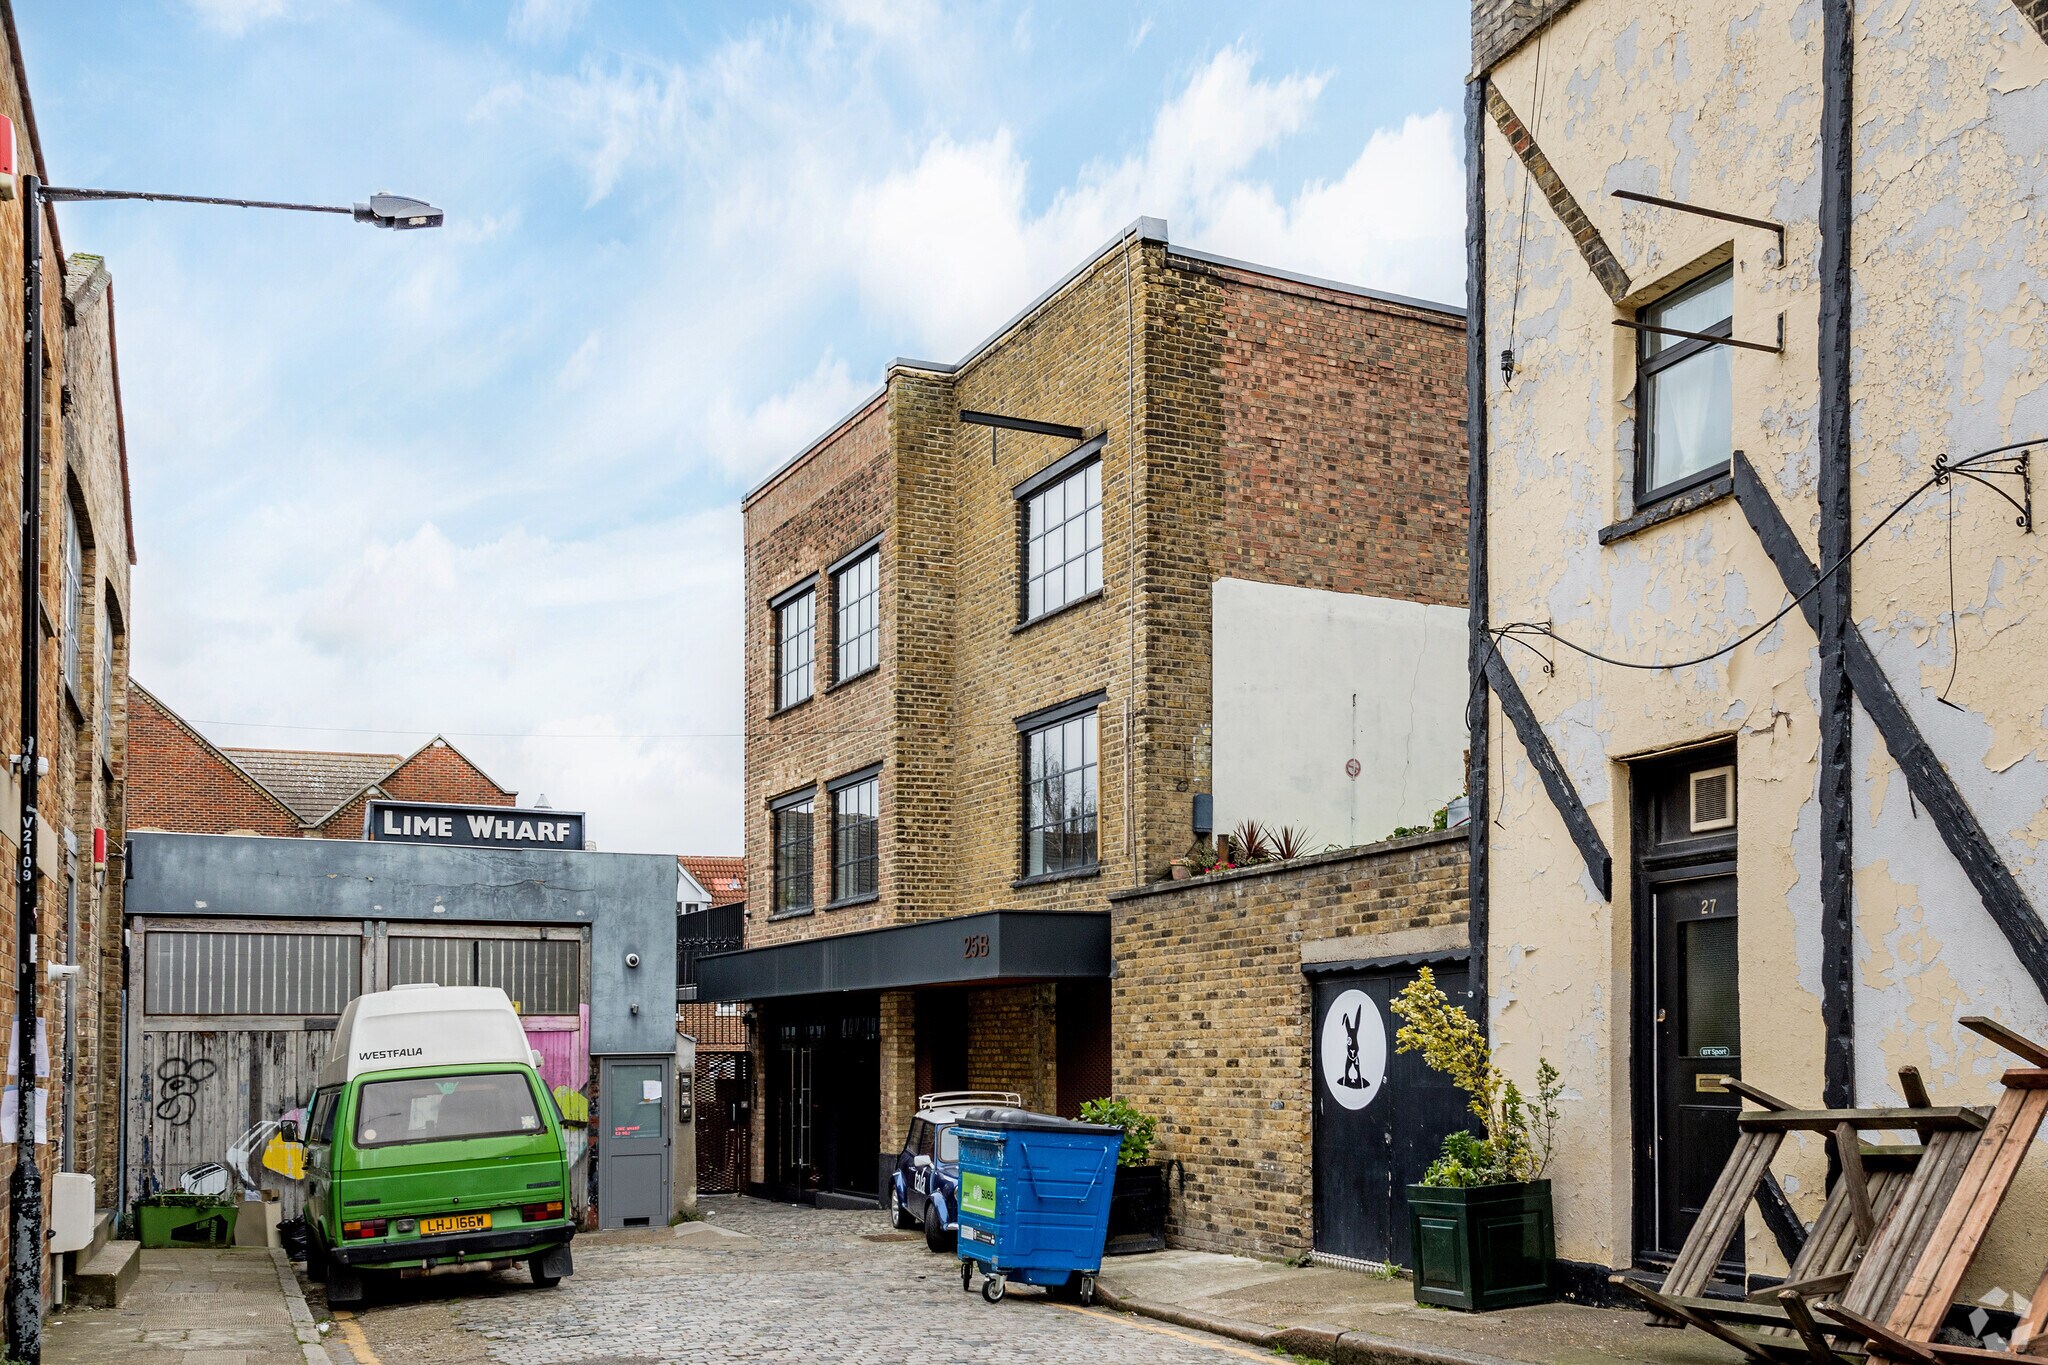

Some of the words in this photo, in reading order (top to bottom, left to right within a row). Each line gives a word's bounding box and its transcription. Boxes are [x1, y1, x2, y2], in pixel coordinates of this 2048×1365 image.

[383, 810, 453, 838] LIME
[466, 815, 571, 842] WHARF
[22, 816, 34, 882] V2109
[1701, 898, 1717, 915] 27
[963, 935, 990, 959] 25B
[359, 1047, 423, 1061] WESTFALIA
[1711, 1048, 1727, 1057] Sport
